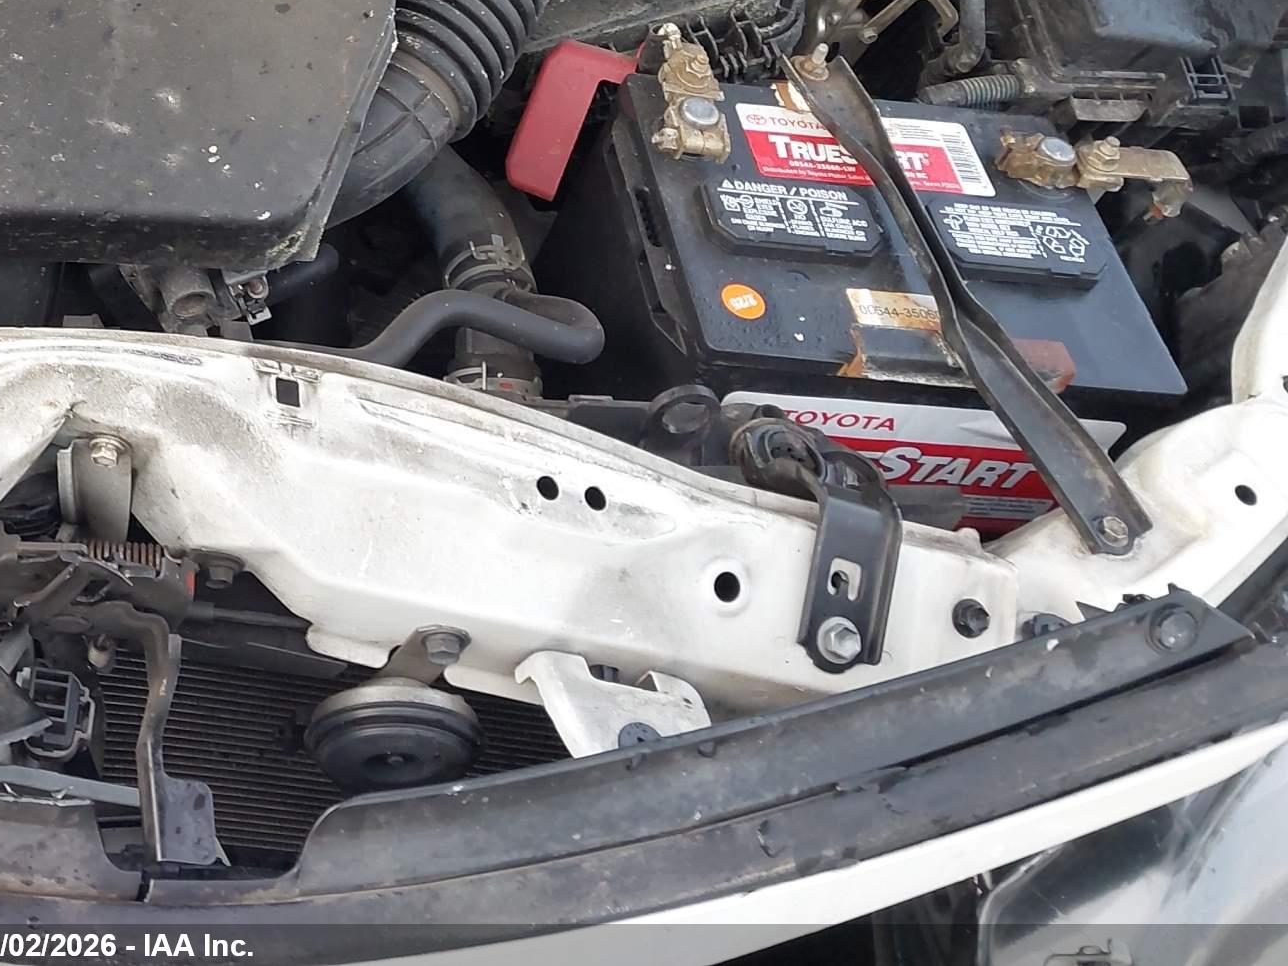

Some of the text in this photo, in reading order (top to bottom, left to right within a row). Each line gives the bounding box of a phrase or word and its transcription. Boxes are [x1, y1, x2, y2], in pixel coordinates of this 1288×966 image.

[769, 117, 826, 131] TOYOTA
[734, 181, 787, 194] DANGER
[799, 188, 848, 201] POISON
[783, 410, 895, 431] TOYOTA
